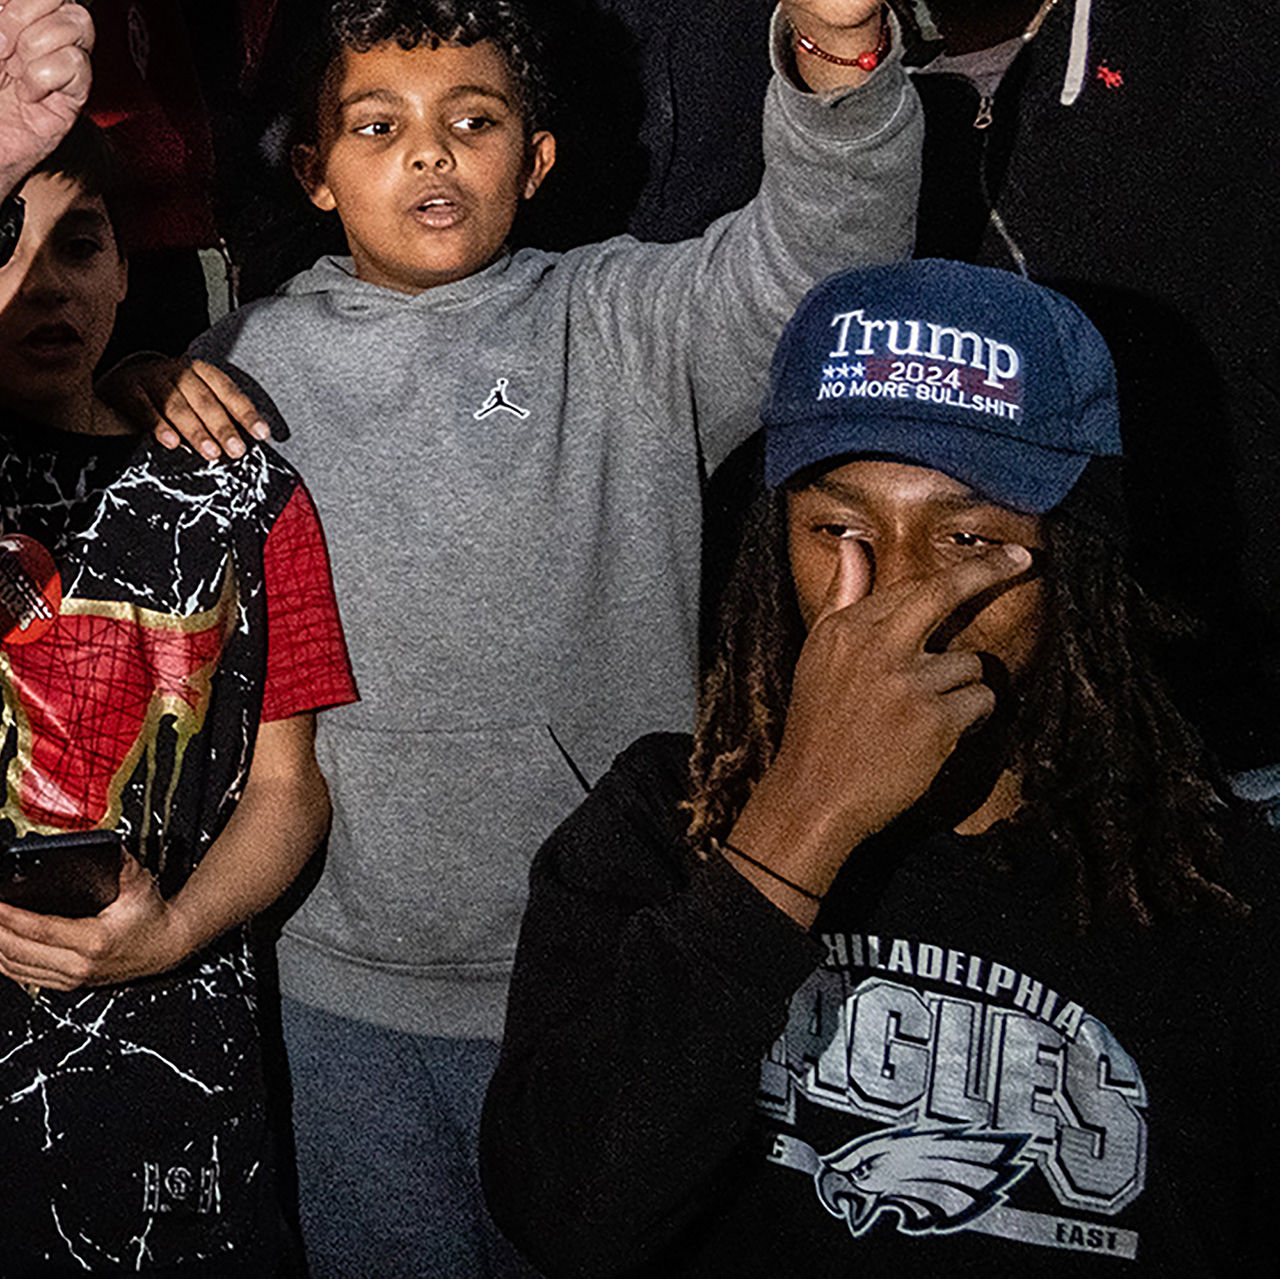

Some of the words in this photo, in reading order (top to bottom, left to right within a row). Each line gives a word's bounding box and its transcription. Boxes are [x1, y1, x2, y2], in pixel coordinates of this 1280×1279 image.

[829, 309, 1020, 389] Trump
[888, 361, 963, 389] 2024
[816, 381, 846, 401] NO
[849, 380, 911, 399] MORE
[914, 383, 1021, 420] BULLSHIT
[820, 932, 1087, 1047] HILADELPHIA
[758, 976, 1149, 1216] AGLES
[1055, 1222, 1119, 1251] EAST
